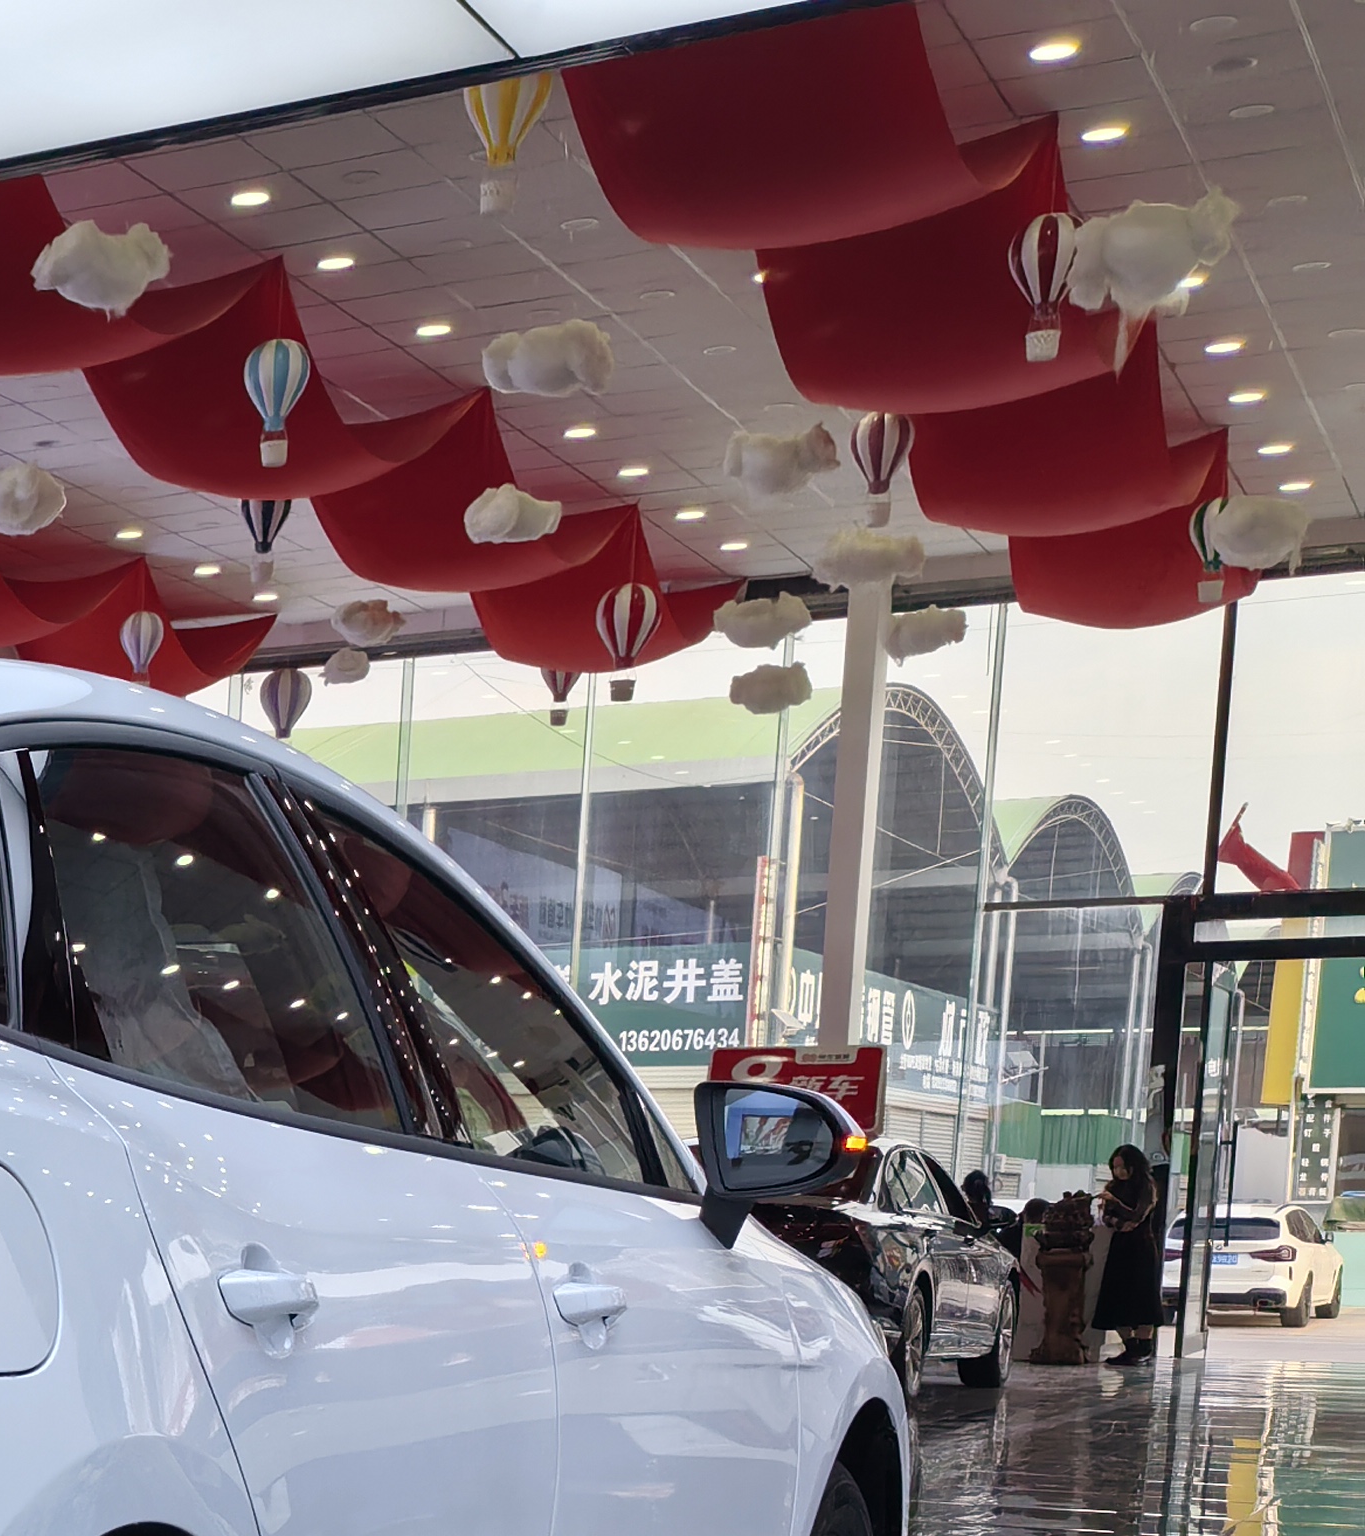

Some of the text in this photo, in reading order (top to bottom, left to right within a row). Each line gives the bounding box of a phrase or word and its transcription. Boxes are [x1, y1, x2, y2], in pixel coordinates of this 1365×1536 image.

[587, 957, 744, 1006] 水泥井盖
[618, 1027, 741, 1053] 13620676434
